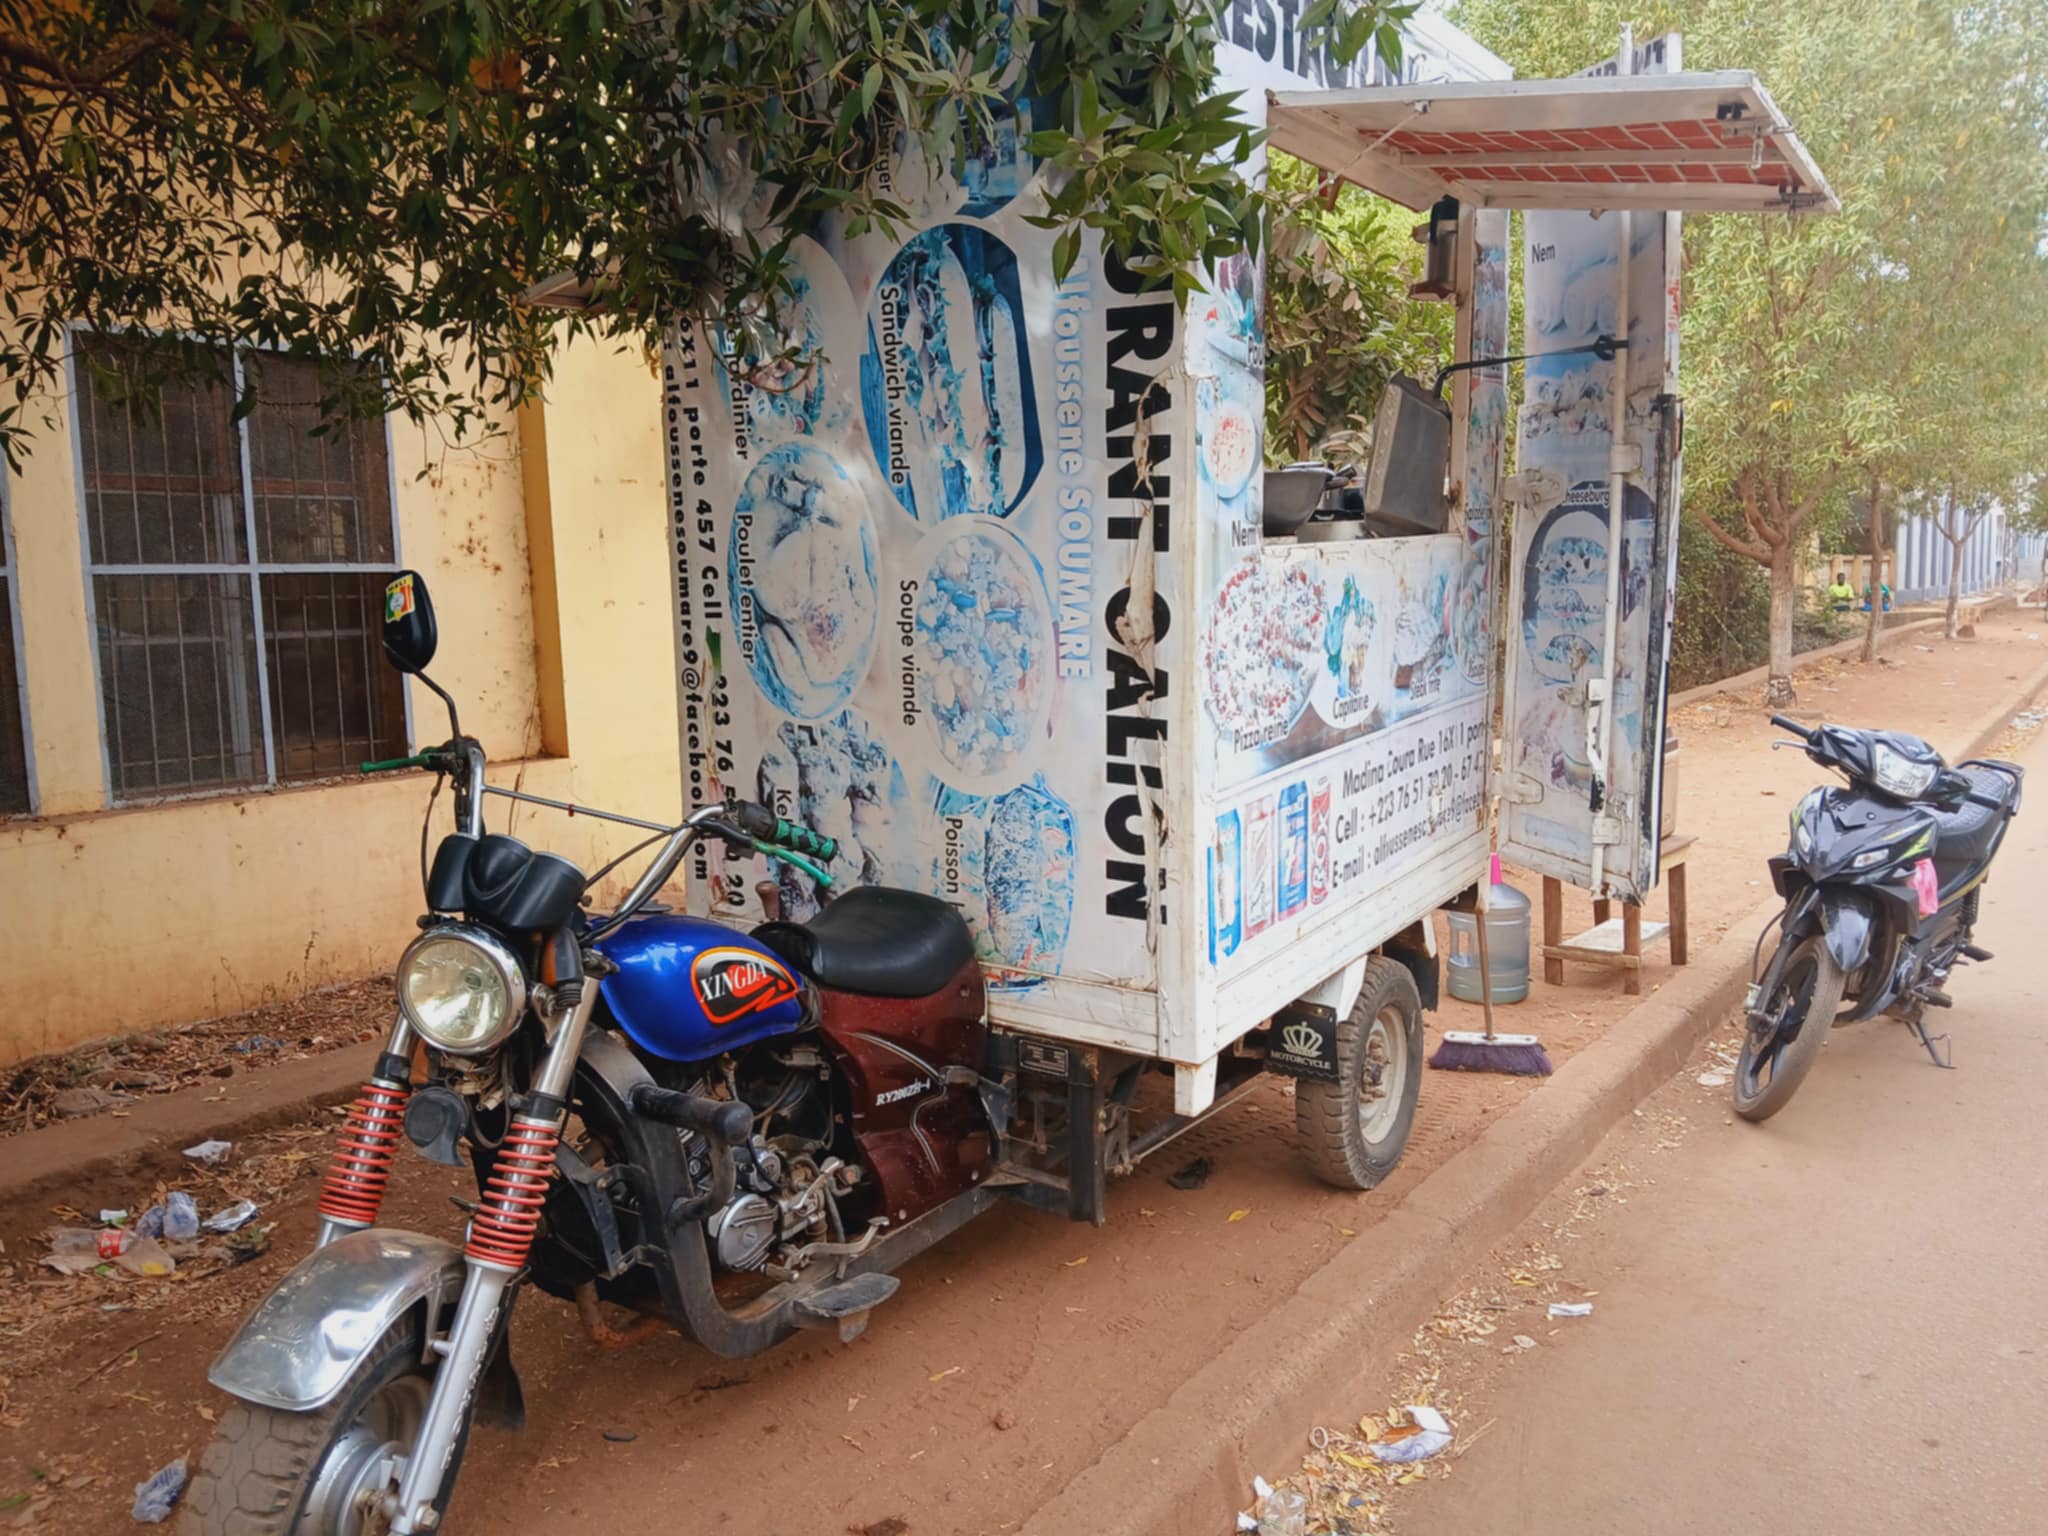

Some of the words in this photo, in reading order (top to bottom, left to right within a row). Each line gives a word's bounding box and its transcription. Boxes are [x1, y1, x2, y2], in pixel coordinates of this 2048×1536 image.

[1531, 244, 1556, 264] Nem
[880, 287, 905, 400] Sandwich
[683, 406, 708, 486] porte
[889, 408, 911, 485] viande
[695, 498, 716, 554] 457
[736, 514, 757, 591] Poulet
[1231, 519, 1257, 547] Nem
[701, 565, 723, 619] Cell
[896, 580, 918, 647] Soupe
[1057, 487, 1093, 678] SOUMARE
[739, 595, 760, 663] entier
[902, 654, 923, 726] viande
[715, 740, 734, 772] 76
[1342, 760, 1384, 799] Madina
[1418, 737, 1435, 763] Rue
[1335, 807, 1358, 844] Cell
[1397, 785, 1410, 813] 76
[1412, 776, 1424, 805] 51
[1461, 754, 1473, 781] 67
[945, 816, 964, 895] Poisson
[726, 874, 745, 907] 20
[700, 959, 771, 1003] XINGDA
[1270, 1049, 1332, 1070] MOTORCYCLE
